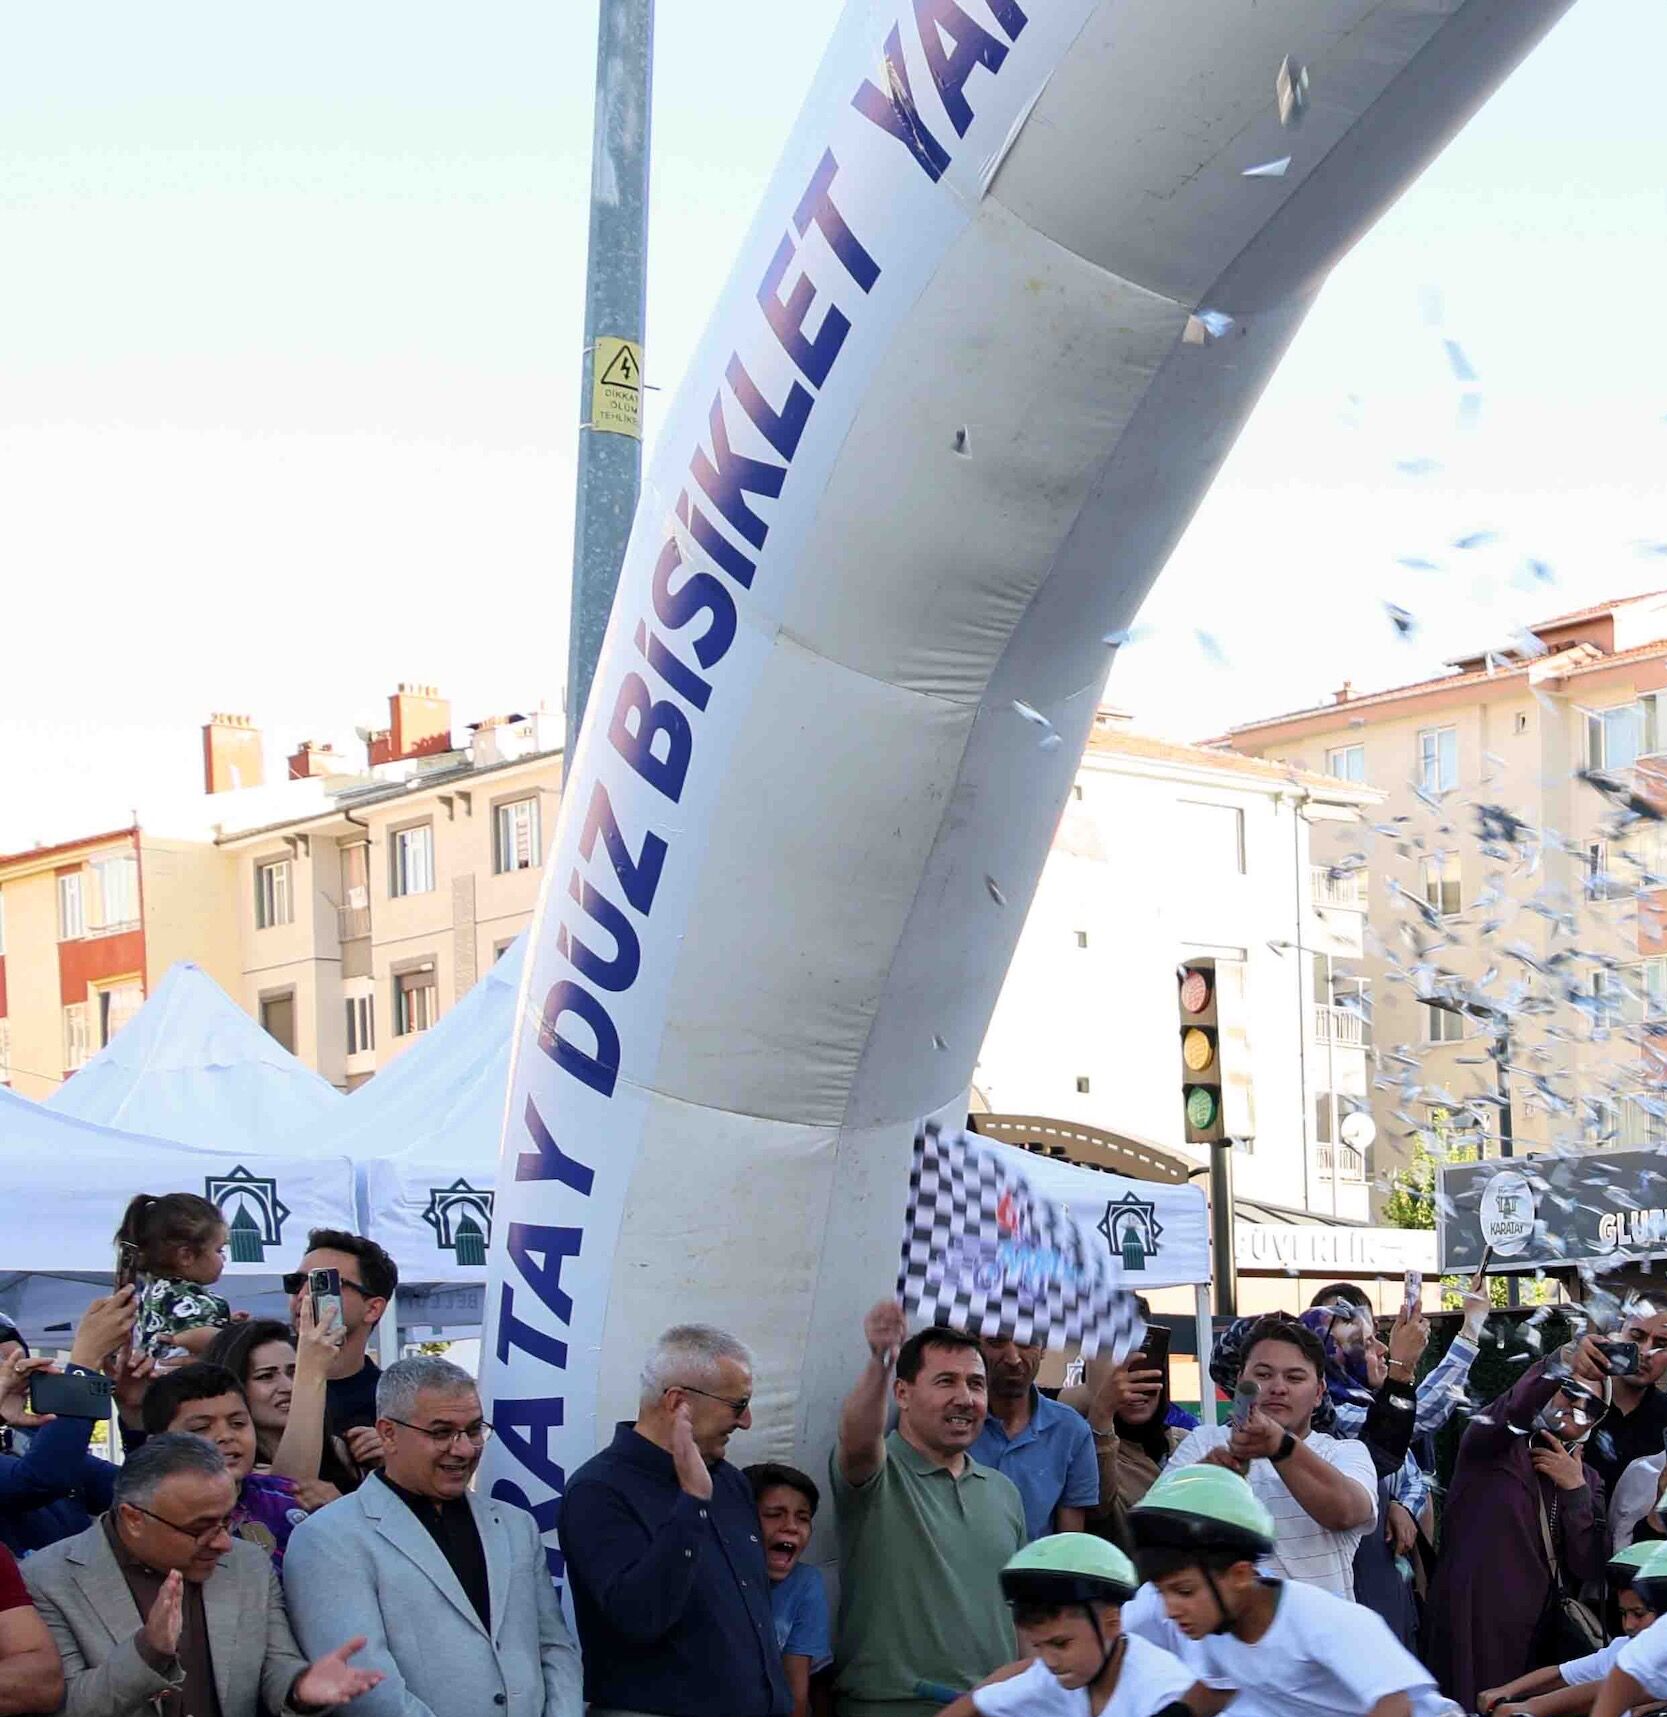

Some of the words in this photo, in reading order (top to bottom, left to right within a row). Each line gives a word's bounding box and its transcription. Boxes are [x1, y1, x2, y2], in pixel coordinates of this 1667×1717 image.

[536, 778, 669, 1099] DÜZ
[607, 144, 882, 804] BİSİKLET
[850, 0, 1028, 184] YA
[1490, 1221, 1524, 1236] KARATAY
